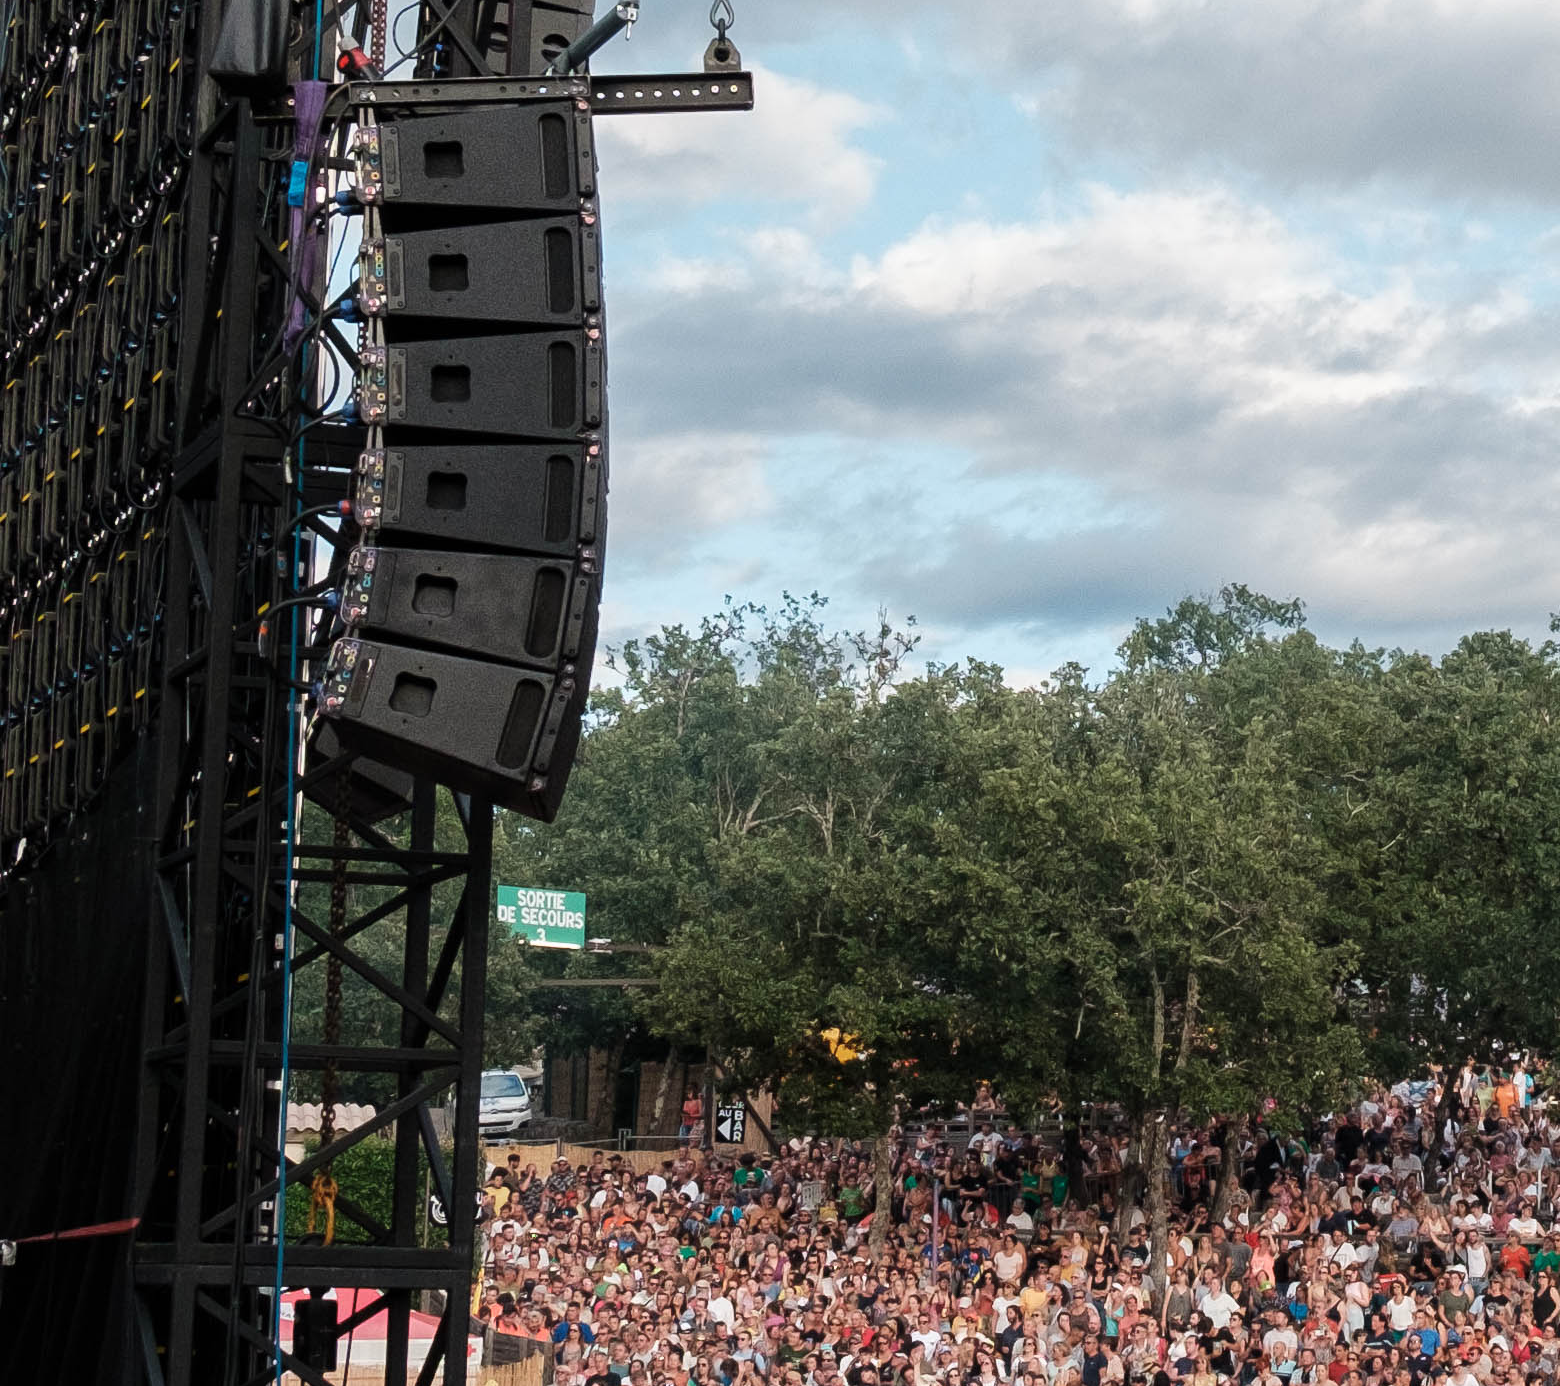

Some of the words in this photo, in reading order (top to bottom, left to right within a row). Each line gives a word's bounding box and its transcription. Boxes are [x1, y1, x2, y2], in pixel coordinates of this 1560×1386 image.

[517, 889, 566, 910] SORTIE
[497, 904, 516, 923] DE
[521, 907, 584, 929] SECOURS
[536, 928, 546, 941] 3
[718, 1109, 732, 1117] AU
[732, 1110, 744, 1142] BAR
